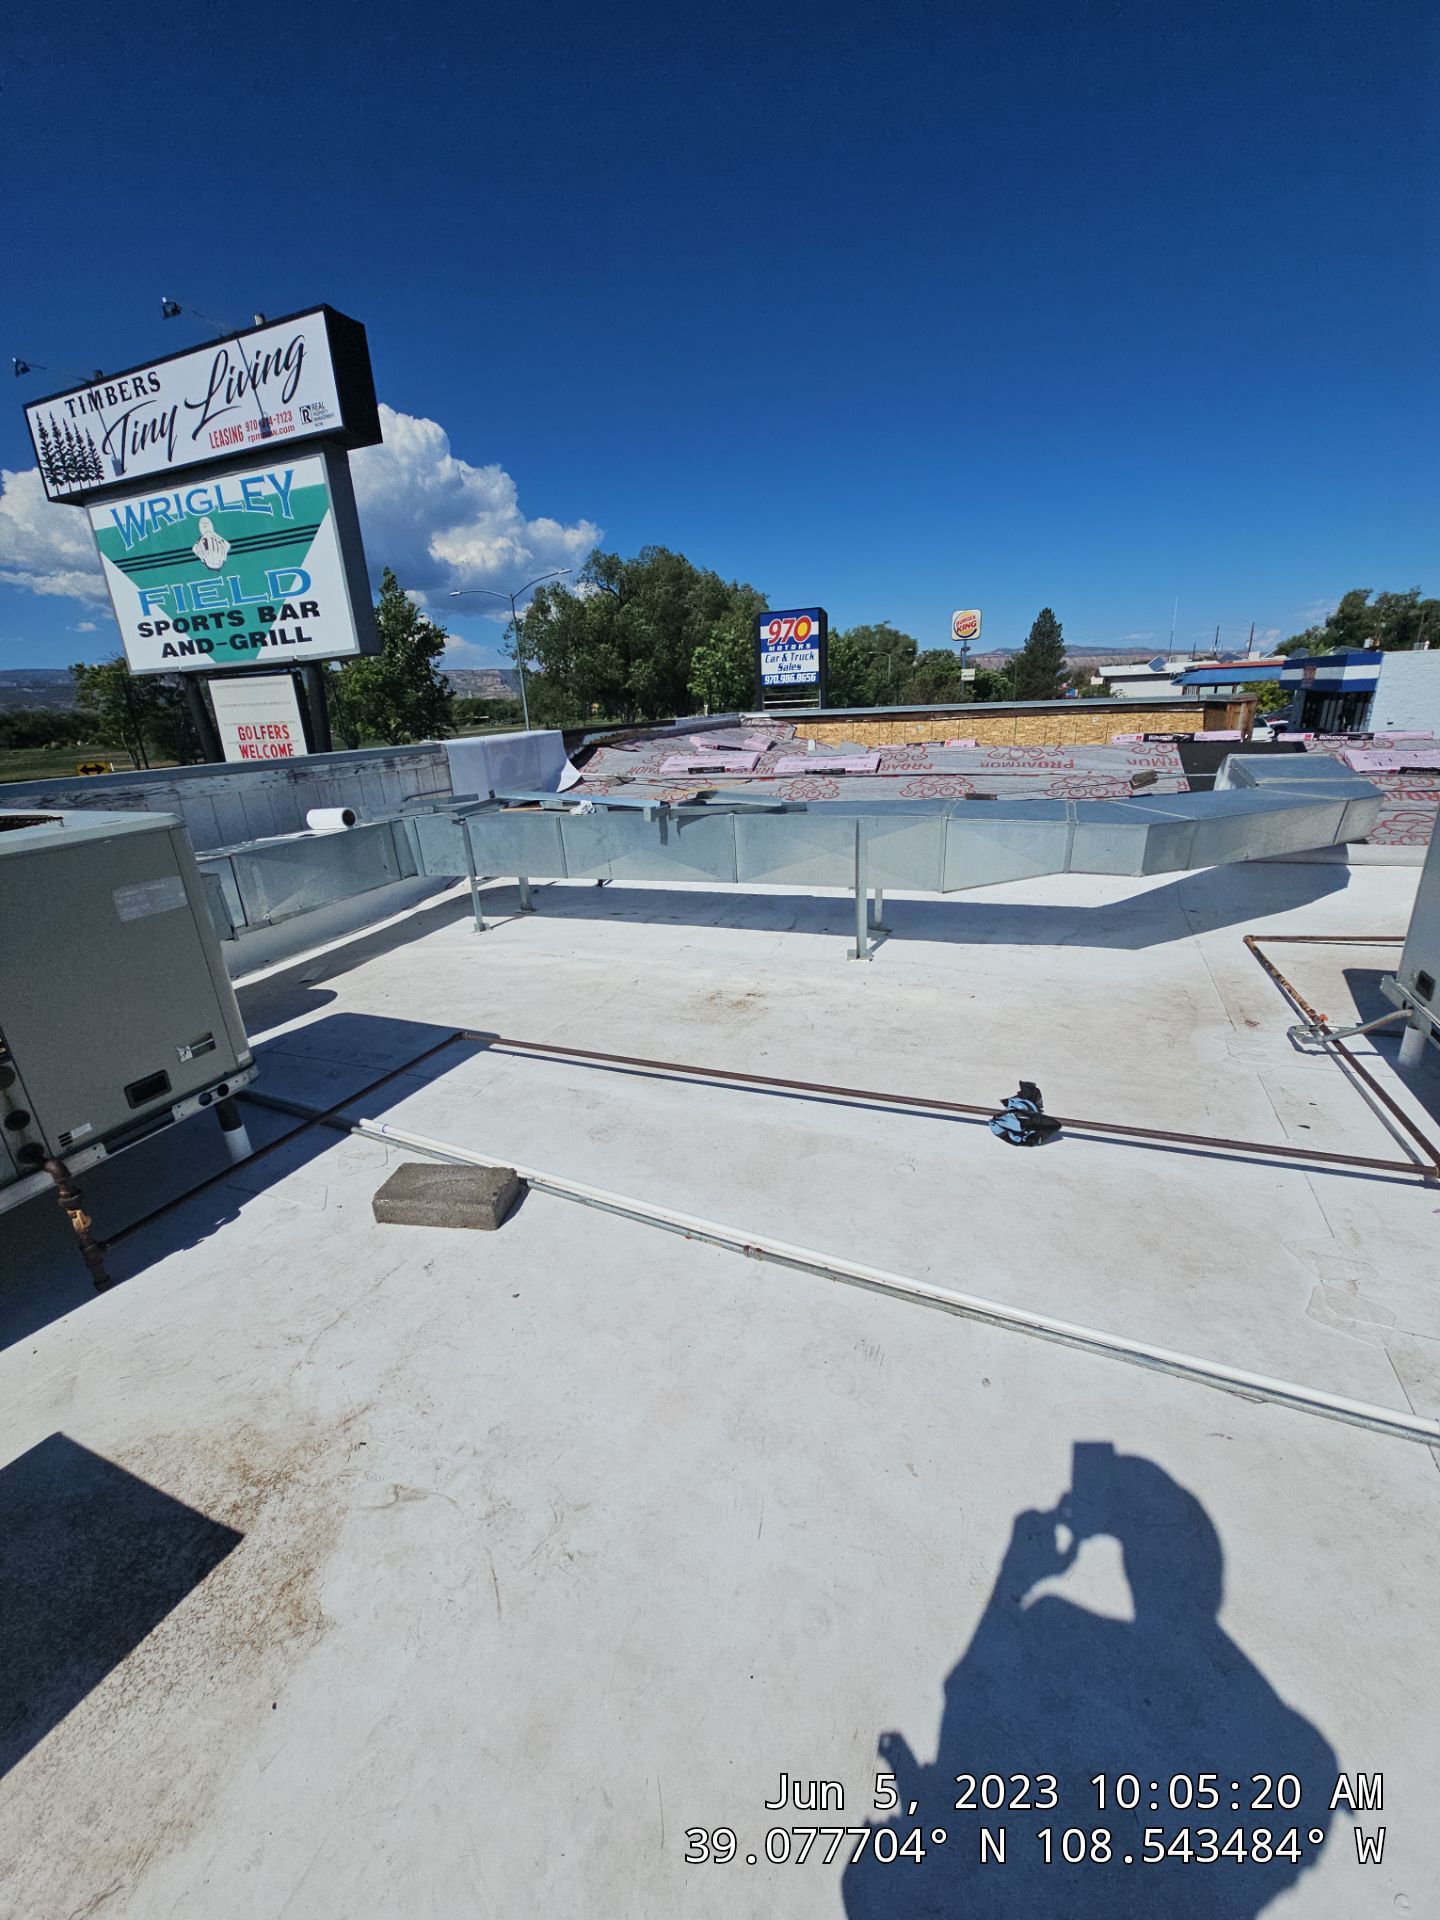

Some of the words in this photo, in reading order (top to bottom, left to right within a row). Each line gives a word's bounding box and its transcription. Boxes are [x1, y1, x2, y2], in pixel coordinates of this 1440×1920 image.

[64, 371, 161, 419] TIMBERS
[102, 399, 178, 474] Tiny
[184, 334, 307, 440] Living
[209, 424, 244, 449] LEASING
[110, 468, 295, 551] WRIGLEY
[137, 566, 312, 617] FIELD
[137, 609, 245, 638] SPORTS
[257, 600, 321, 624] BAR
[767, 615, 812, 646] 970
[956, 620, 977, 633] KING
[161, 626, 313, 659] AND-GRILL
[768, 643, 811, 652] MOTORS
[765, 654, 780, 663] Car
[781, 652, 789, 662] &
[790, 651, 815, 661] Truck
[777, 662, 802, 671] Sales
[237, 724, 290, 741] GOLFERS
[238, 743, 295, 759] WELCOME
